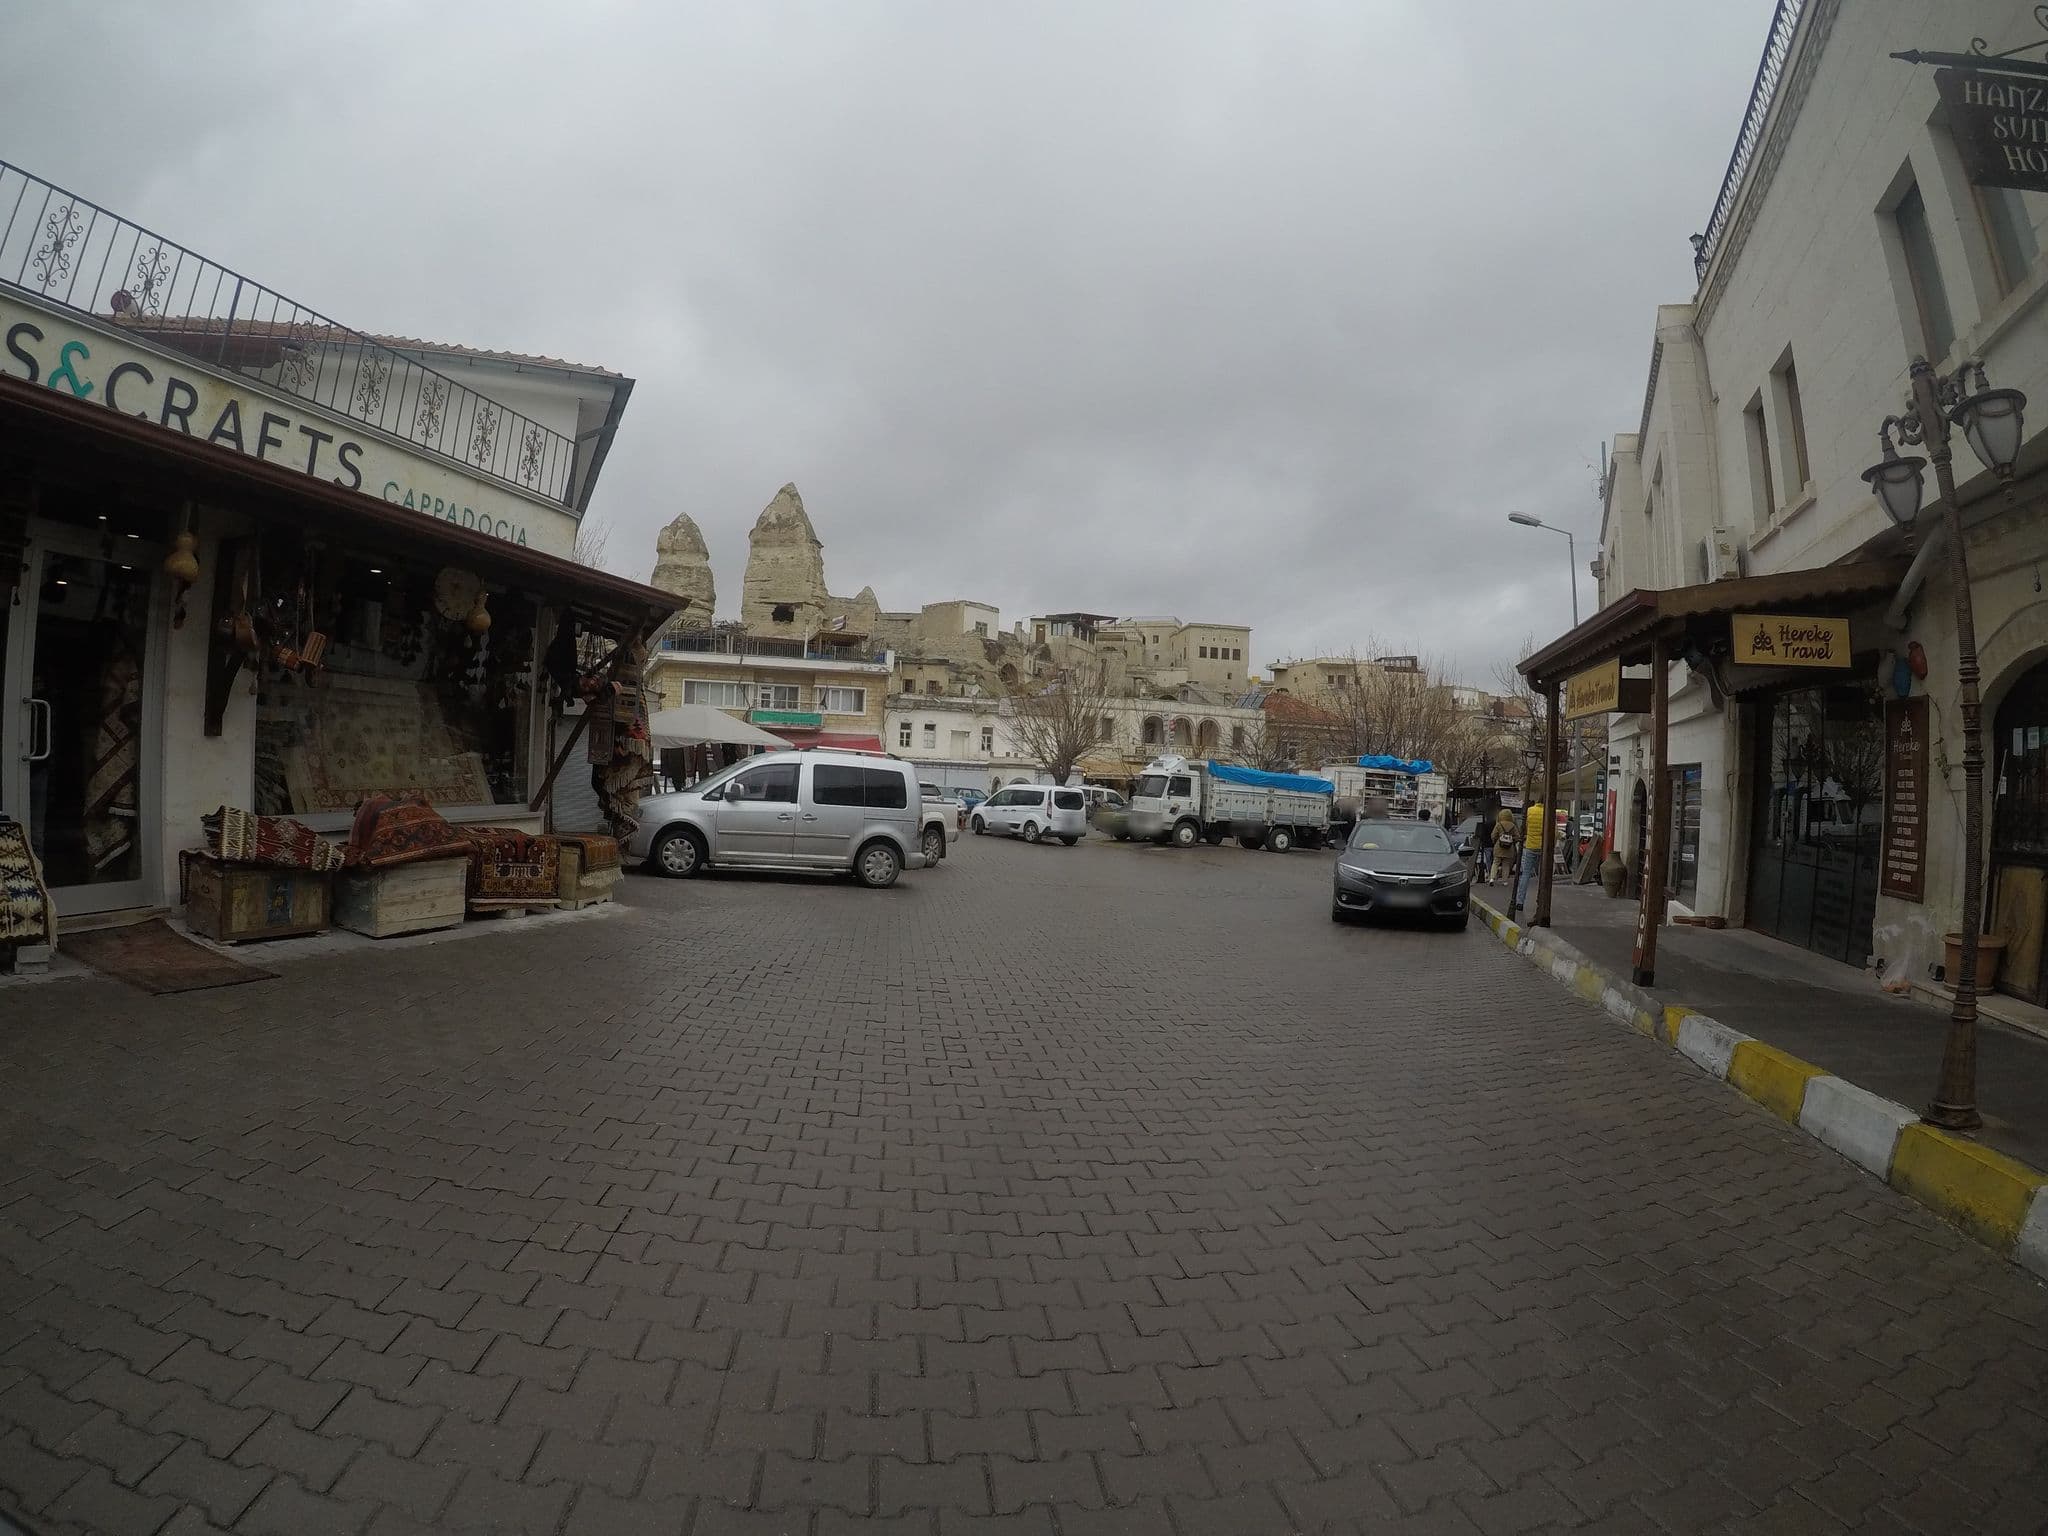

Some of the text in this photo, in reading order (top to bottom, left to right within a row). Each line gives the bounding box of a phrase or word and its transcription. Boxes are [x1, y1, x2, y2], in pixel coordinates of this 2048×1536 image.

[1964, 79, 2048, 115] HANZ
[2002, 144, 2048, 172] HO
[383, 481, 526, 547] CAPPADOCIA
[1778, 624, 1834, 642] Hereke
[1782, 642, 1834, 660] Travel
[1893, 737, 1920, 753] Hereke
